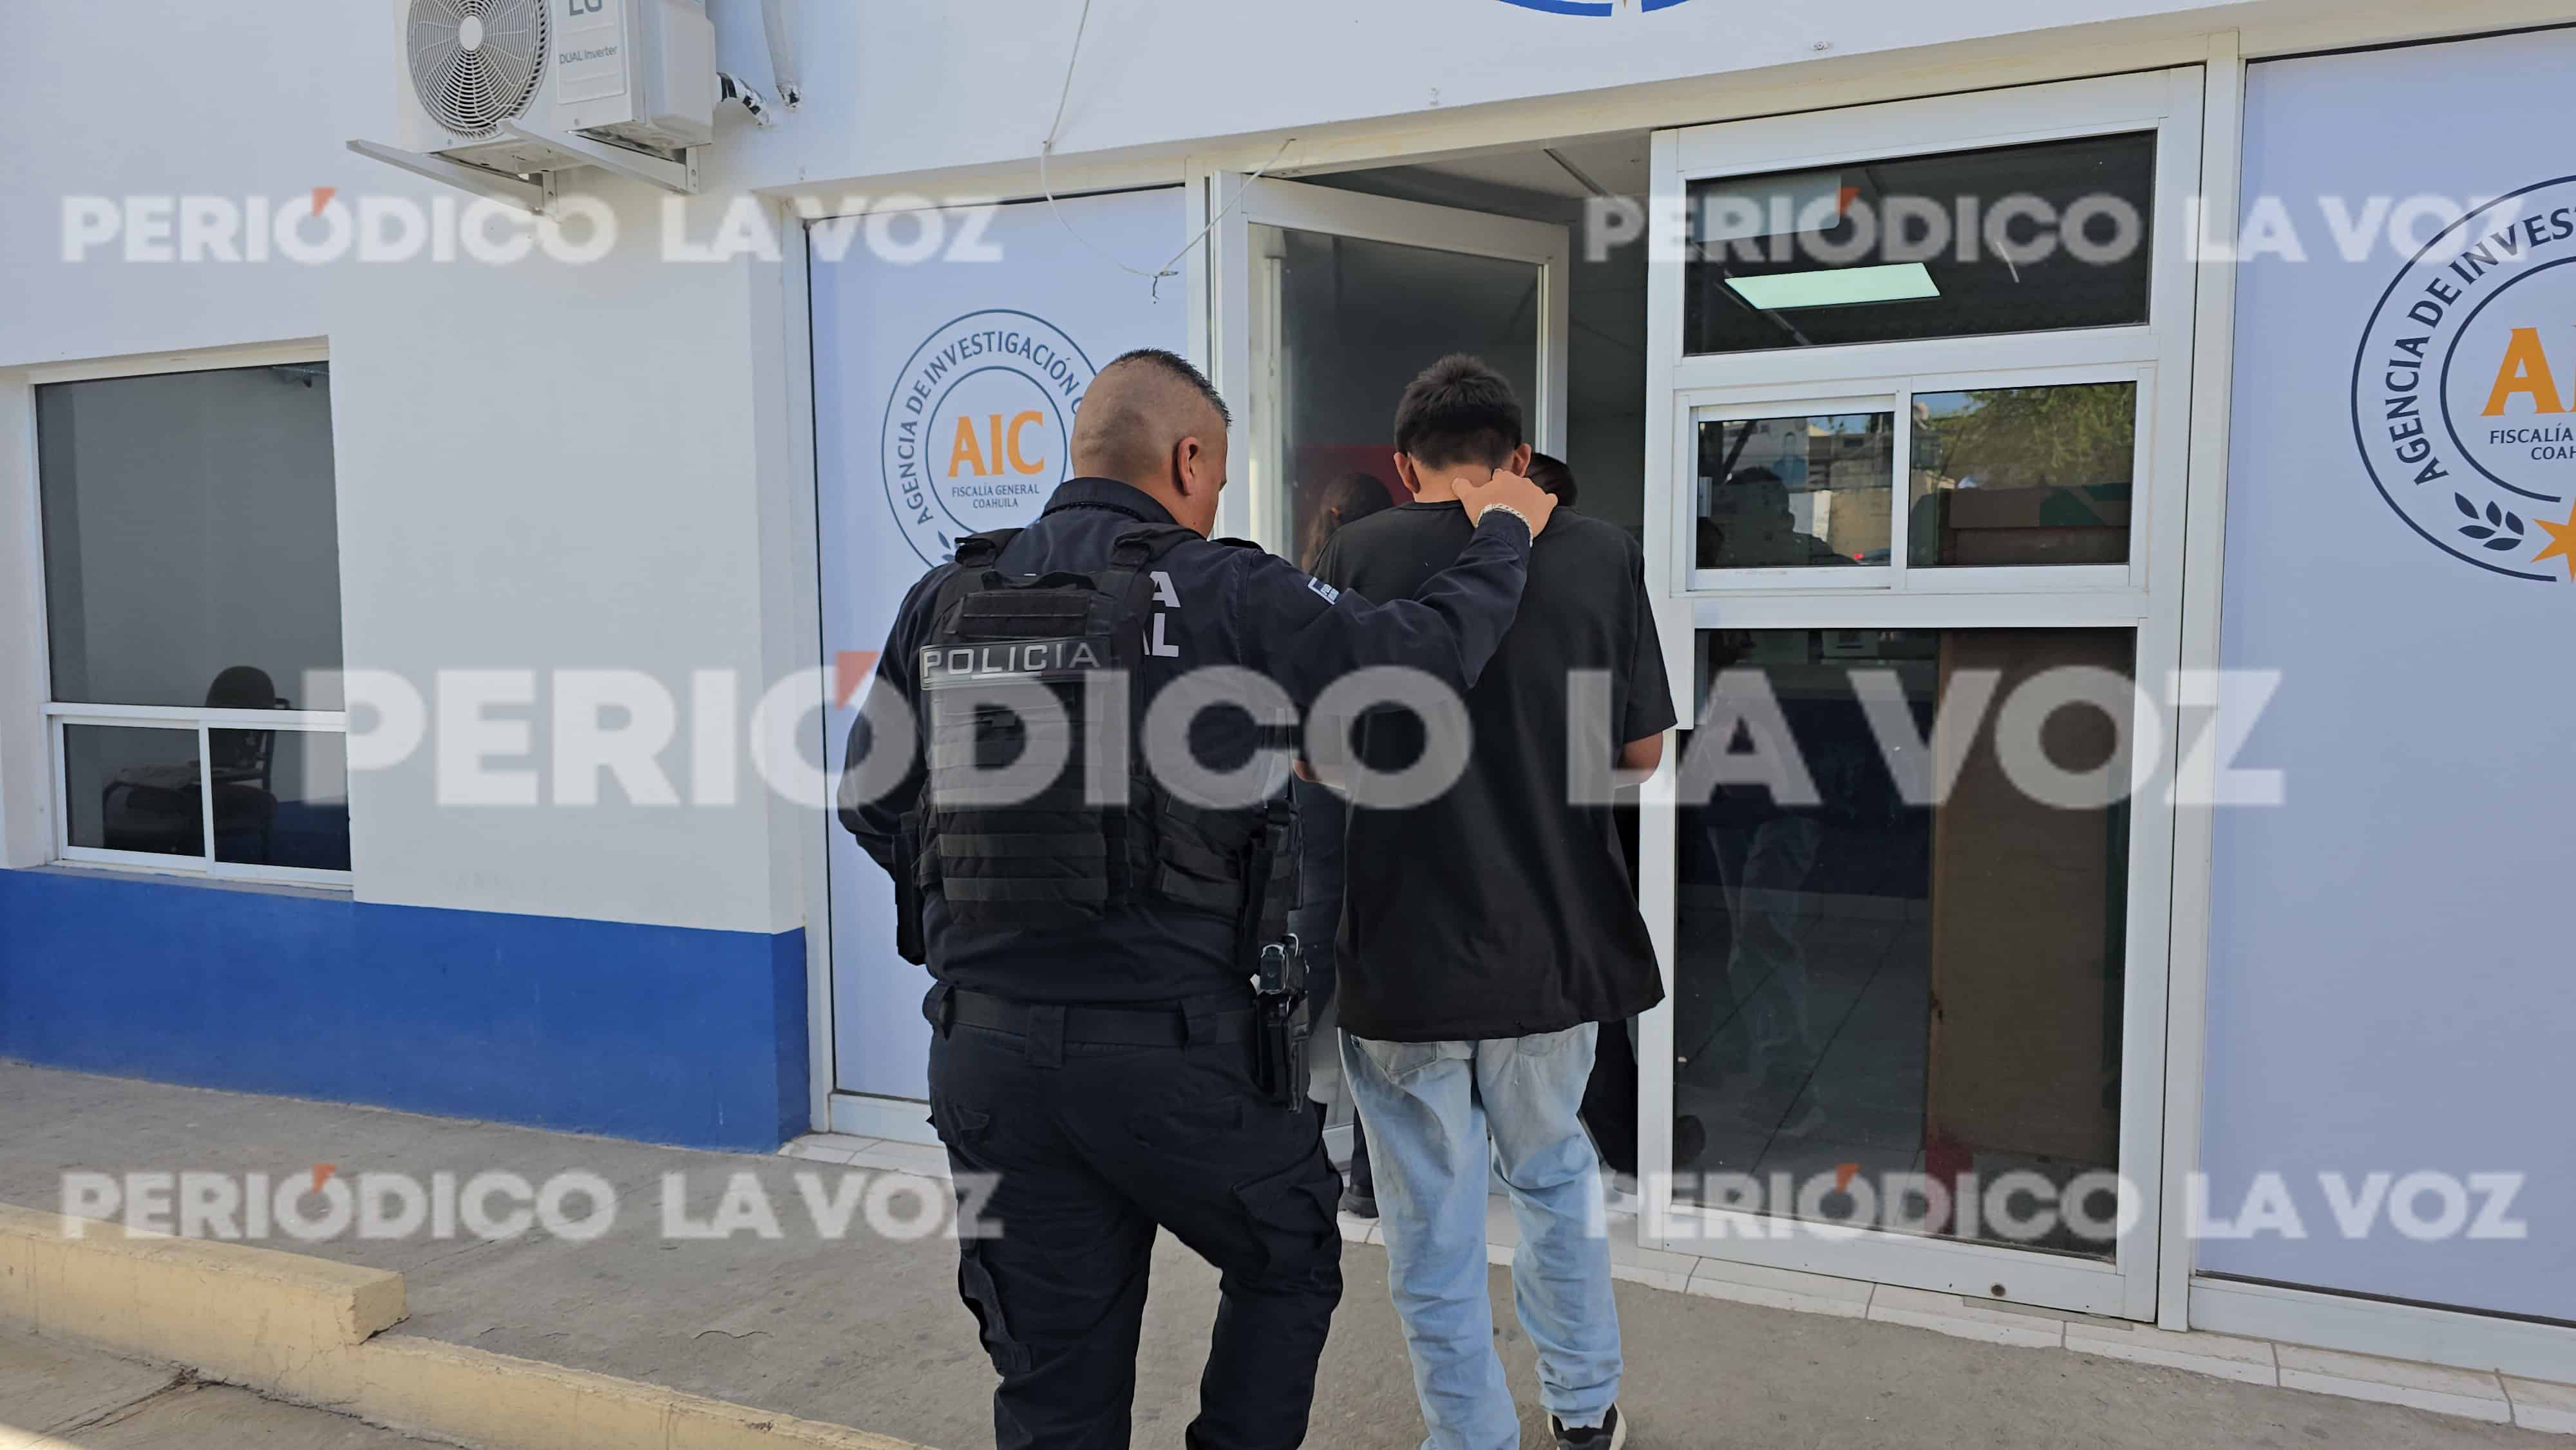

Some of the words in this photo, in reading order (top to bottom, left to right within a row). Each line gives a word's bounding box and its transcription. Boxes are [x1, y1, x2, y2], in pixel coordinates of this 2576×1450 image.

[558, 51, 583, 64] DUAL
[2447, 207, 2576, 285] INVES
[2407, 278, 2463, 329] DE
[923, 331, 1080, 397] INVESTIGACIÓN
[905, 380, 932, 415] DE
[2385, 335, 2450, 485] AGENCIA
[947, 410, 1045, 478] AIC
[2488, 422, 2574, 444] FISCALÍA
[898, 420, 933, 524] AGENCIA
[995, 484, 1040, 496] GENERAL
[973, 498, 1019, 509] COAHUILA
[922, 642, 1101, 678] POLICIA
